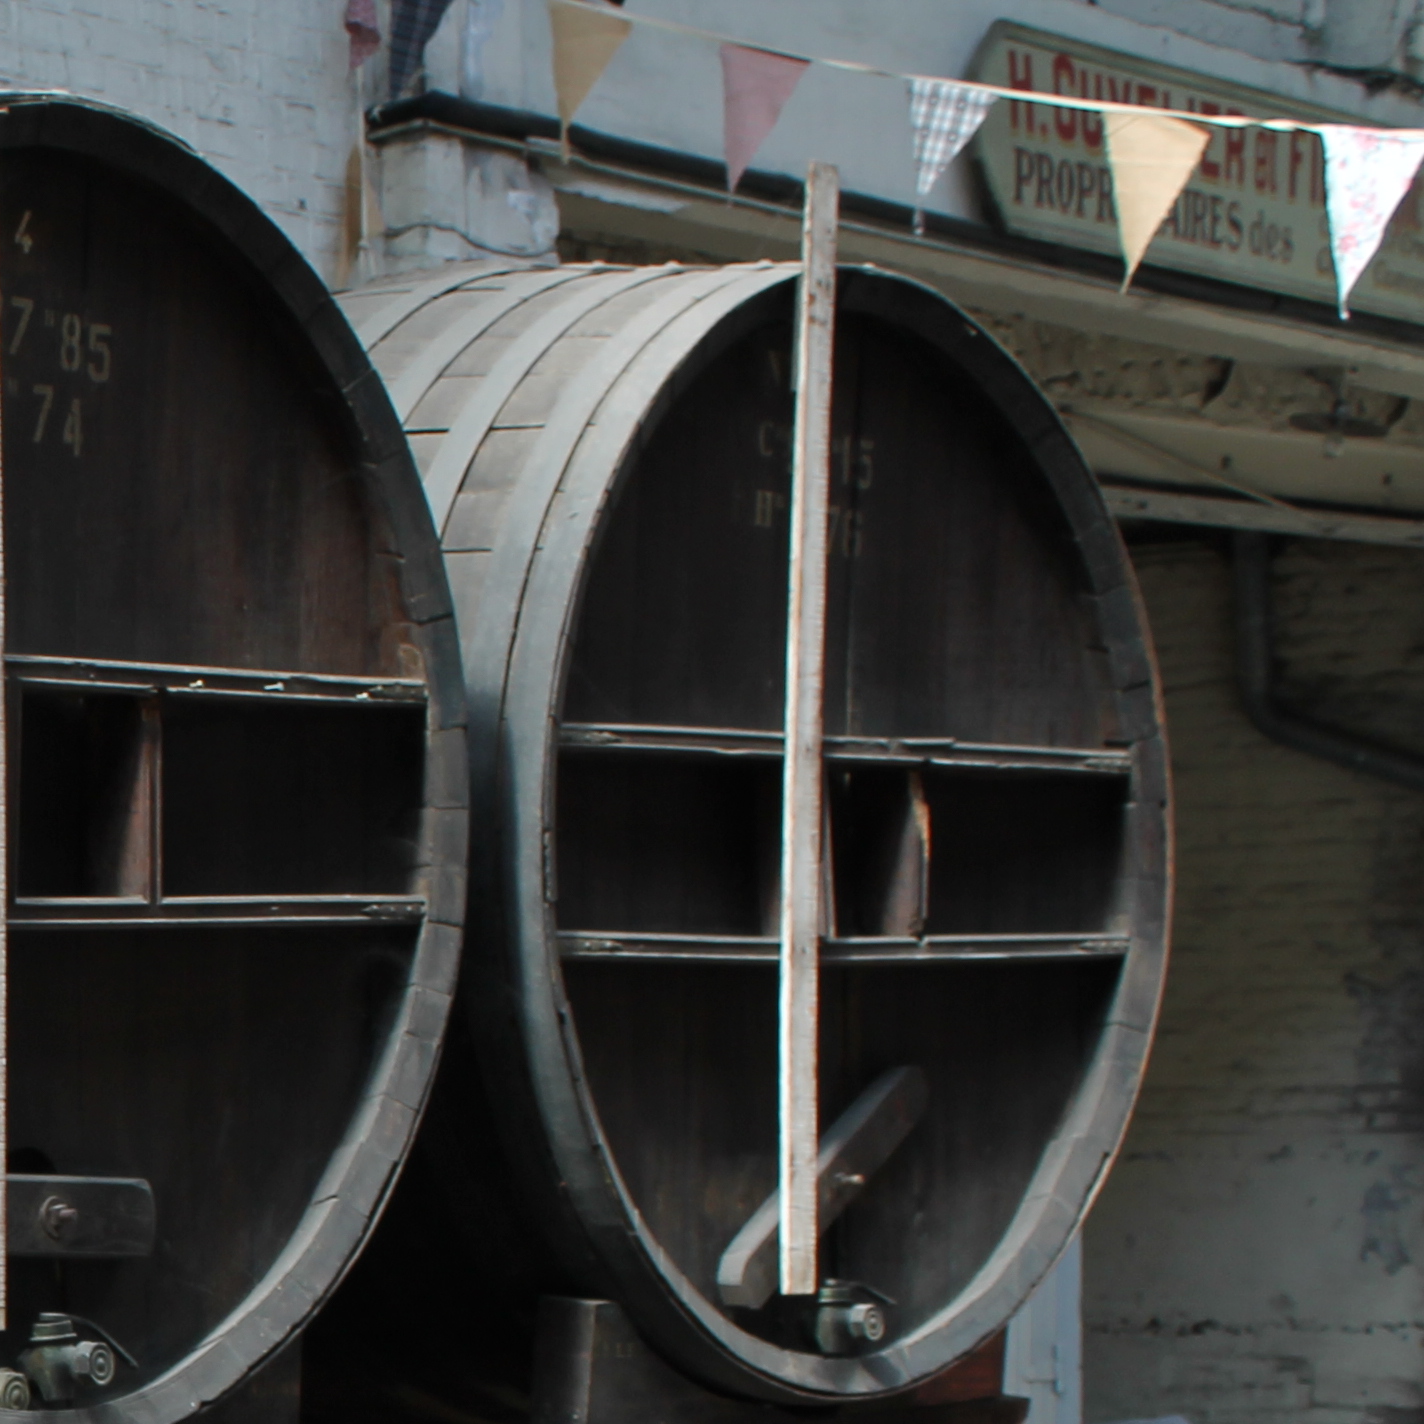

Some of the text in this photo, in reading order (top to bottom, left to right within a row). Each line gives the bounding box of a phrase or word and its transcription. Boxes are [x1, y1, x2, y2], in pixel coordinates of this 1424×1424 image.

[15, 210, 33, 253] 4
[1012, 146, 1244, 252] PROPRAIRES
[1247, 208, 1293, 264] des
